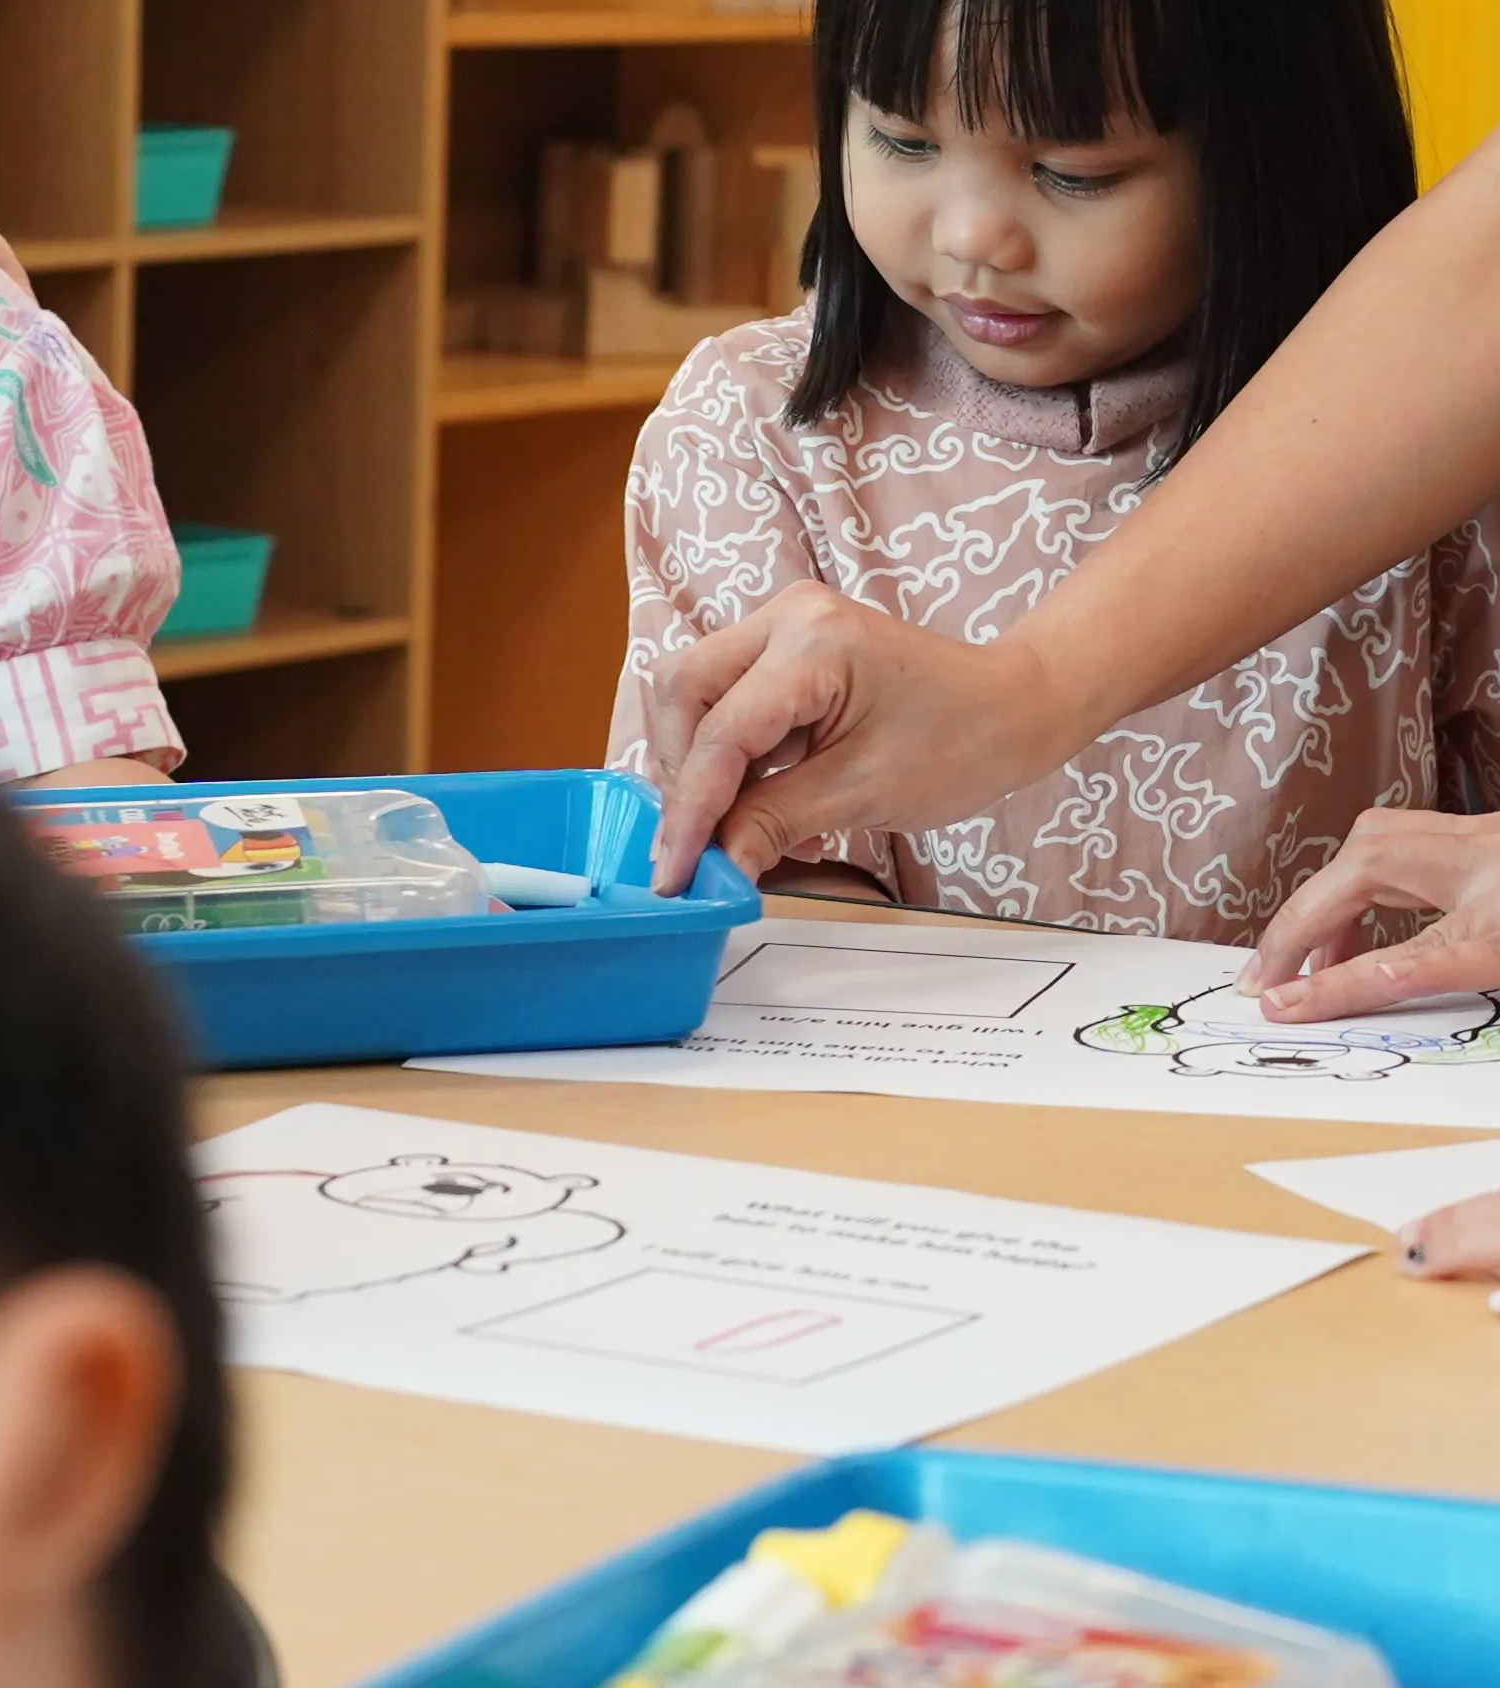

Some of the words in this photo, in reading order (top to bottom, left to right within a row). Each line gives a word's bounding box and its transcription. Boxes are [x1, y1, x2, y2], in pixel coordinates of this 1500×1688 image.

[759, 1014, 827, 1024] a/an
[835, 1019, 892, 1029] him
[900, 1022, 964, 1031] give
[971, 1026, 1025, 1034] will
[758, 1040, 814, 1048] him
[824, 1043, 904, 1052] make
[727, 1048, 790, 1056] give
[955, 1051, 1023, 1059] bear
[930, 1059, 1009, 1068] What
[746, 1200, 826, 1218] What
[832, 1213, 890, 1225] will
[891, 1222, 950, 1234] you
[955, 1231, 1023, 1244] give
[1030, 1239, 1081, 1252] the
[787, 1223, 819, 1234] to
[825, 1229, 909, 1246] make
[914, 1240, 974, 1256] him
[659, 1246, 718, 1260] will
[718, 1256, 786, 1271] give
[792, 1264, 852, 1281] him
